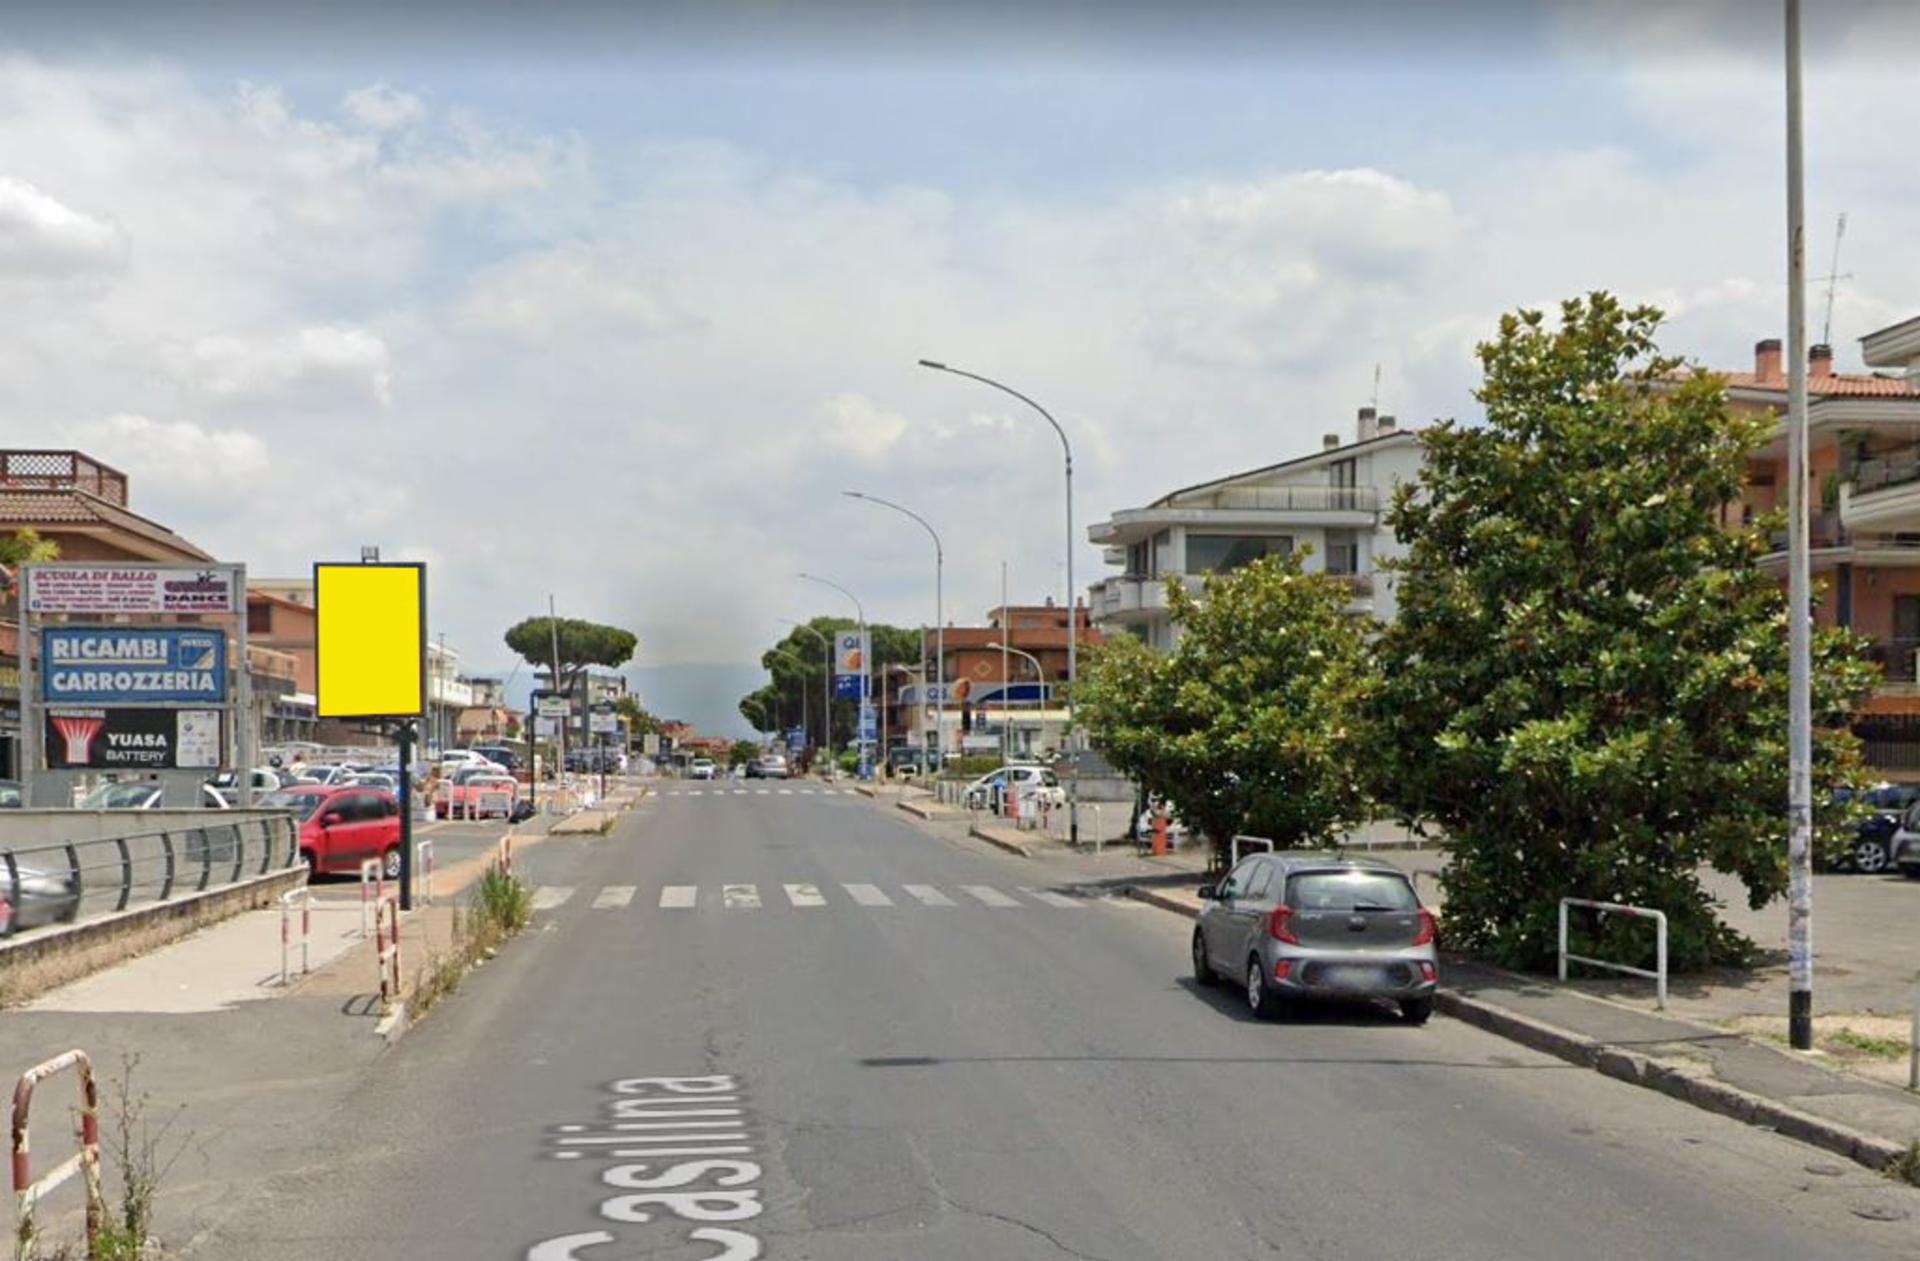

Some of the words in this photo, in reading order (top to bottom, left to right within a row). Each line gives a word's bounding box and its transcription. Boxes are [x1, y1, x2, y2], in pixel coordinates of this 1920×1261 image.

[34, 571, 88, 581] SCUOLA
[91, 572, 107, 581] DI
[110, 572, 157, 581] BALLO
[164, 594, 228, 602] DANCE
[52, 638, 168, 658] RICAMBI
[52, 671, 215, 691] CARROZZERIA
[107, 733, 167, 747] YUASA
[105, 750, 167, 762] BATTERY
